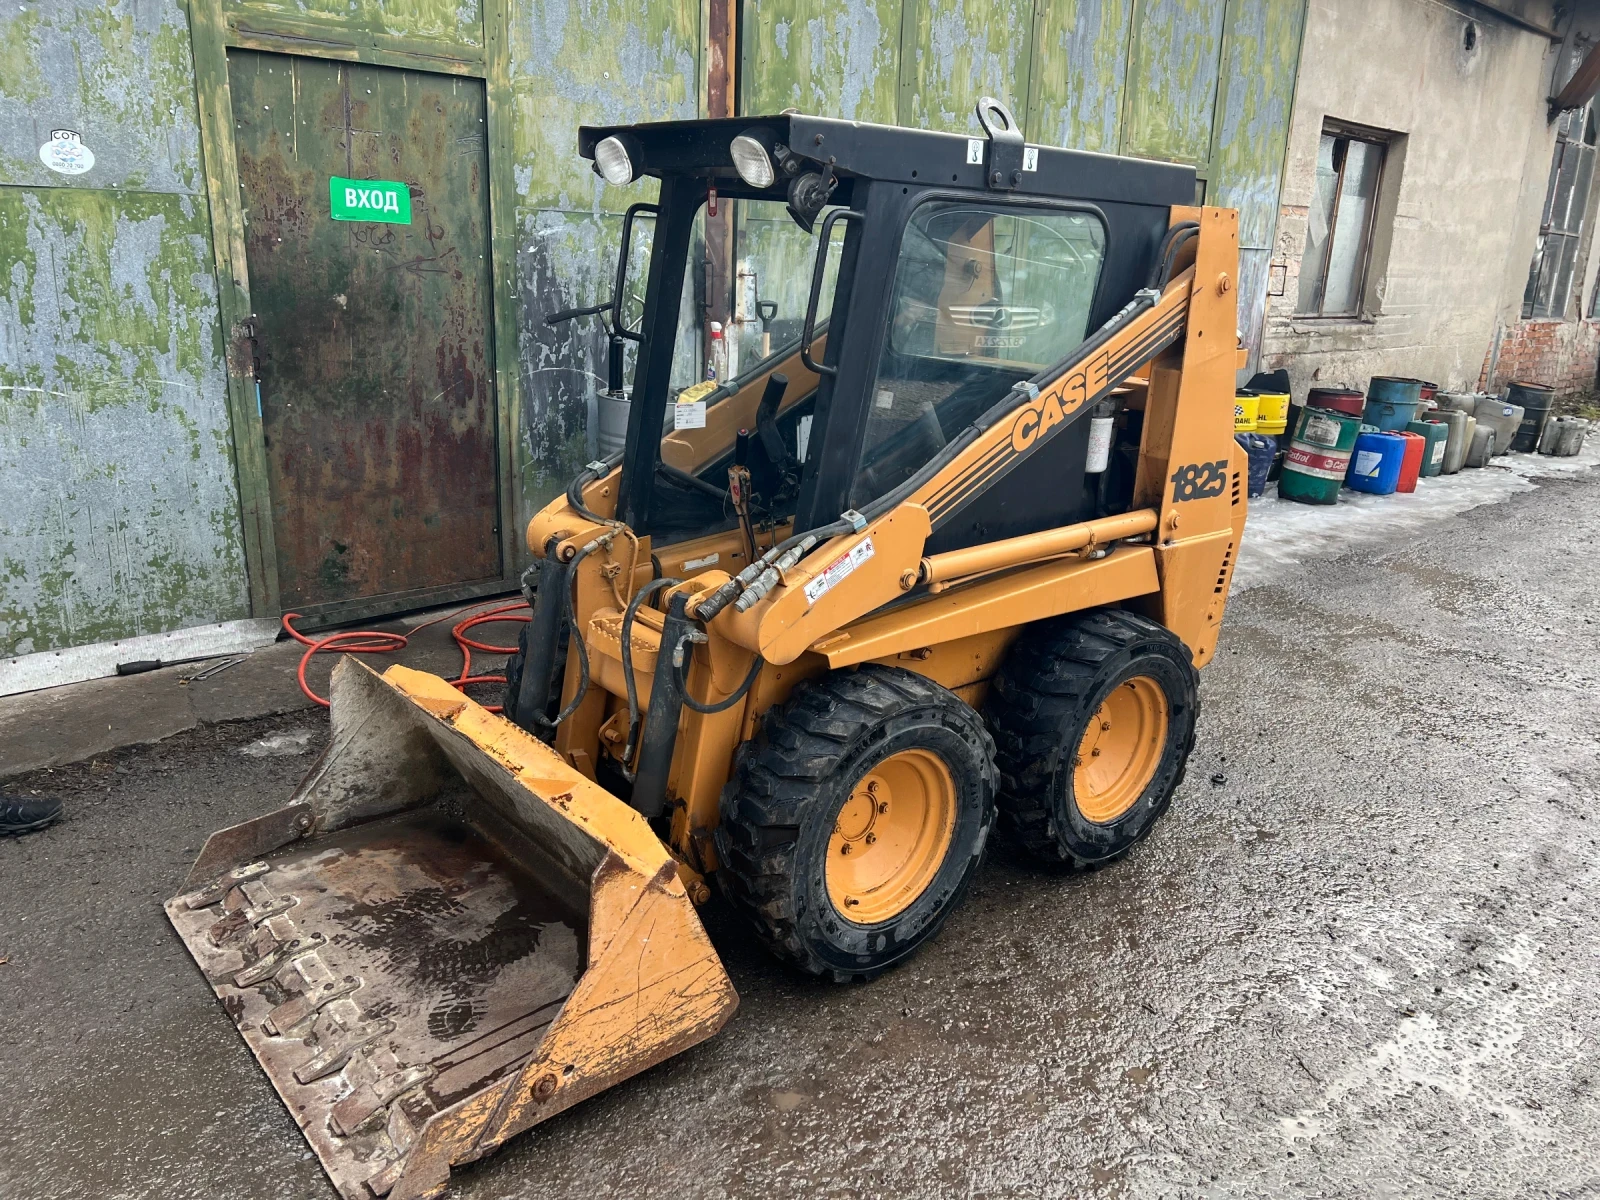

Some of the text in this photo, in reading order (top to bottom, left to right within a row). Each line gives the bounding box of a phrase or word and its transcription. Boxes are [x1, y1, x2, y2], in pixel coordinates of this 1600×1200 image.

[345, 188, 399, 213] ВХОД
[1011, 350, 1109, 452] CASE
[1171, 460, 1228, 503] 1825
